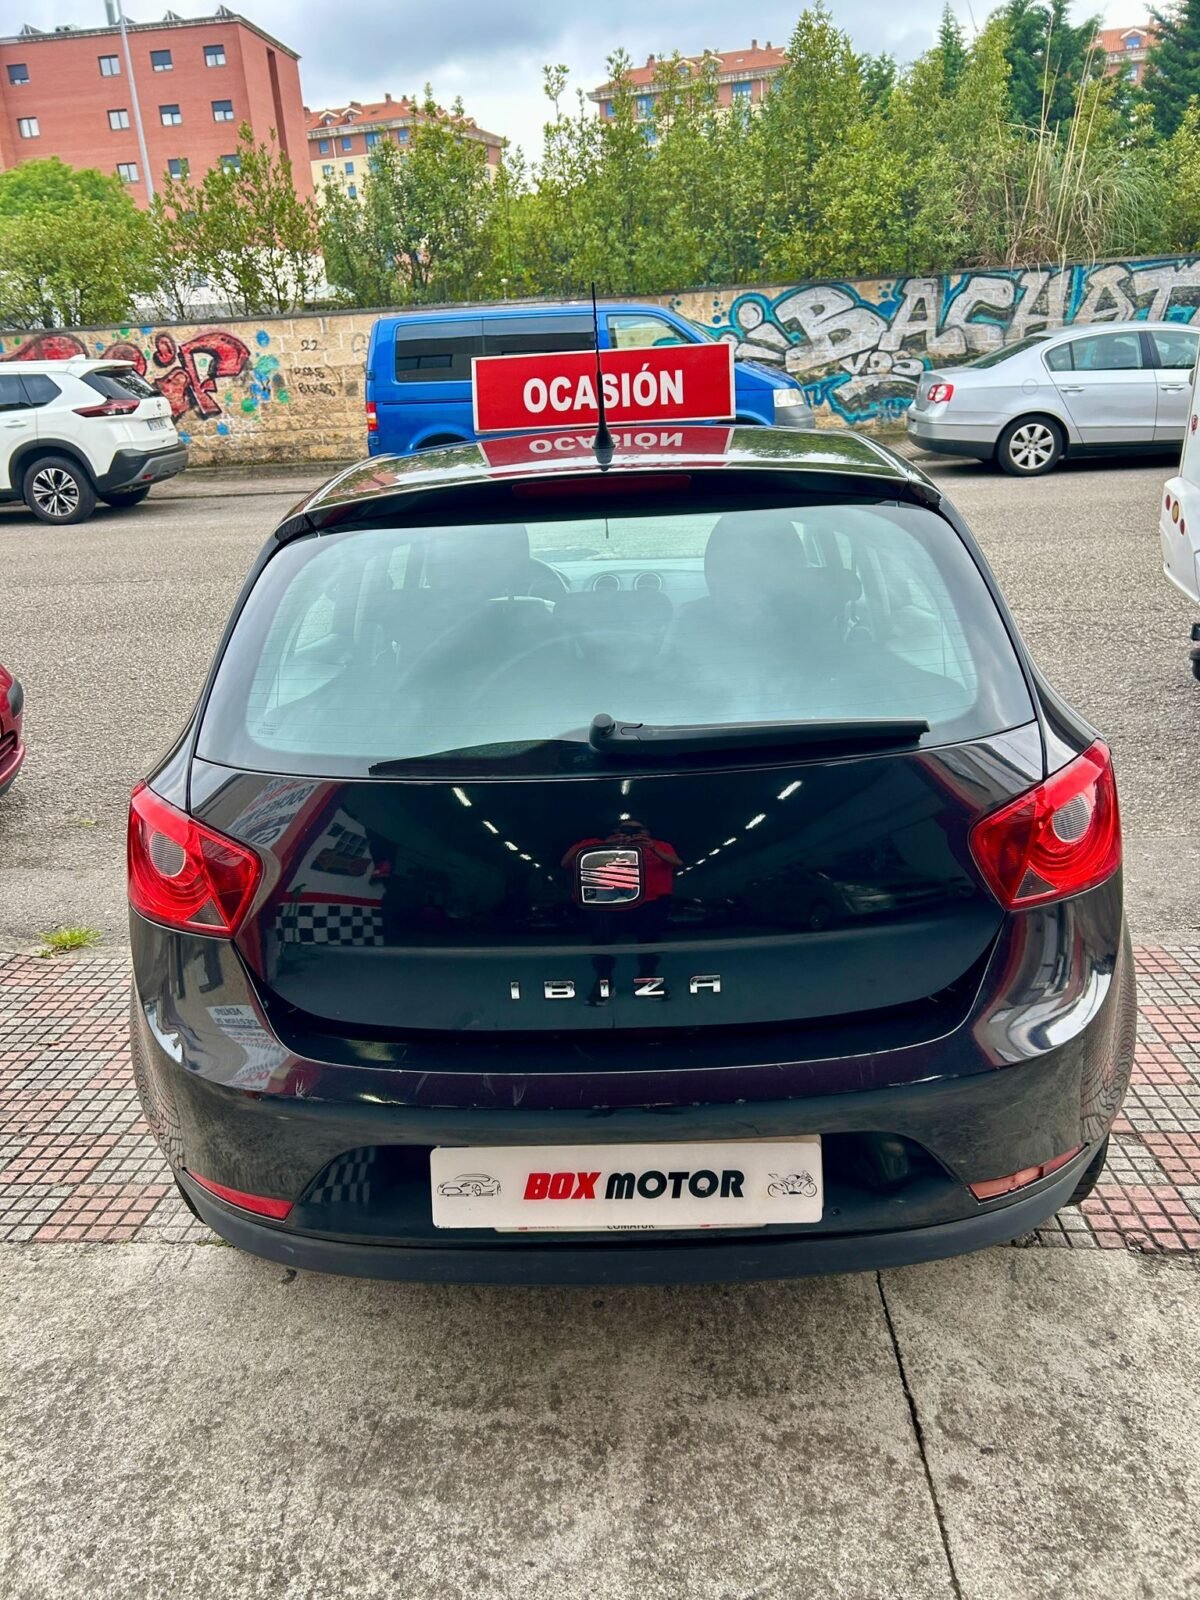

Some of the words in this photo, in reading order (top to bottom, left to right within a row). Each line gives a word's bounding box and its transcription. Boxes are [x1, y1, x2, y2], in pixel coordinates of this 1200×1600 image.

[774, 261, 1200, 372] BACHAT
[523, 363, 683, 413] OCASIÓN
[510, 975, 721, 999] IBIZA
[524, 1171, 601, 1200] BOX
[605, 1169, 745, 1199] MOTOR
